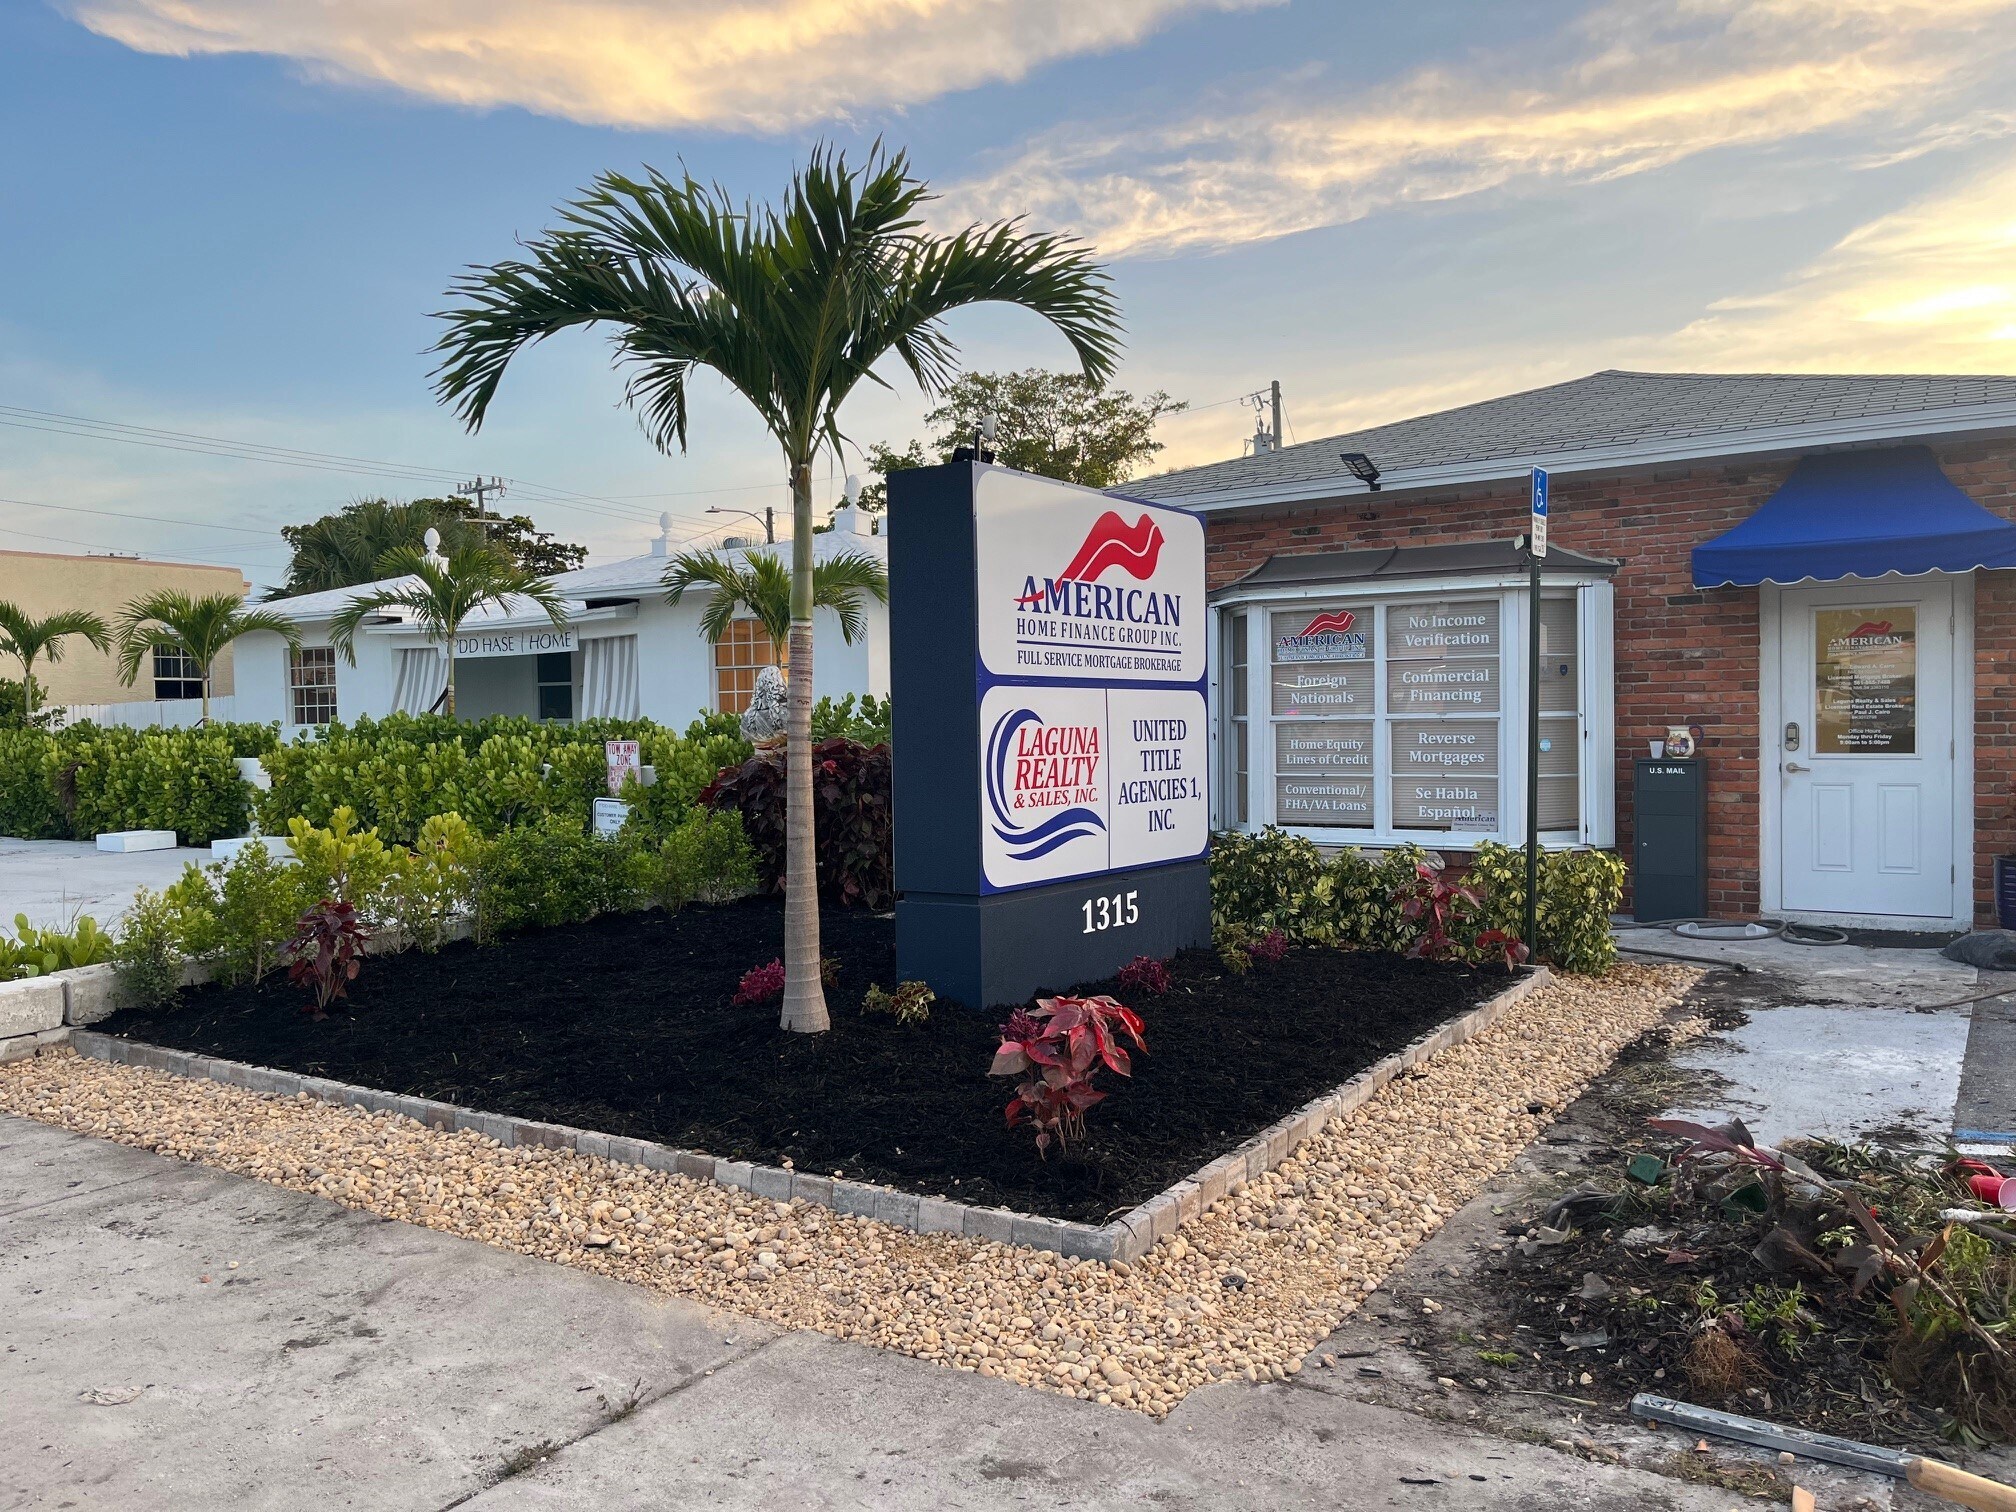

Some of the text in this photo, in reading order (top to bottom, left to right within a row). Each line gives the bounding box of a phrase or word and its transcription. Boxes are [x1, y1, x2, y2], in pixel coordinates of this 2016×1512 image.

[1017, 576, 1181, 626] AMERICAN
[1409, 615, 1486, 628] No Income
[1017, 618, 1182, 646] HOME FINANCE GROUP INC.
[483, 636, 514, 652] HASE
[530, 632, 571, 649] HOME
[1277, 632, 1366, 647] AMERICAN
[1405, 632, 1490, 647] Verification
[1828, 636, 1902, 646] AMERICAN
[1017, 650, 1182, 672] FULL SERVICE MORTGAGE BROKERAGE
[1297, 676, 1347, 688] Foreign
[1402, 669, 1490, 683] Commercial
[1291, 692, 1354, 704] Nationals
[1410, 689, 1482, 704] Financing
[1133, 720, 1186, 742] UNITED
[1017, 727, 1100, 757] LAGUNA
[1290, 739, 1364, 751] Home Equity
[1418, 733, 1476, 744] Reverse
[608, 744, 636, 754] TOW AWAY
[617, 754, 631, 765] ZONE
[1140, 749, 1181, 772] TITLE
[1286, 754, 1368, 764] Lines of Credit
[1410, 751, 1485, 765] Mortgages
[1014, 756, 1100, 791] REALTY
[1118, 777, 1201, 805] AGENCIES 1,
[1285, 784, 1366, 798] Conventional/
[1416, 787, 1478, 799] Se Habla
[1014, 788, 1098, 809] & SALES, INC.
[1285, 799, 1367, 811] FHA/VA Loans
[1148, 808, 1175, 832] INC.
[1418, 806, 1475, 820] Español
[1082, 890, 1139, 934] 1315
